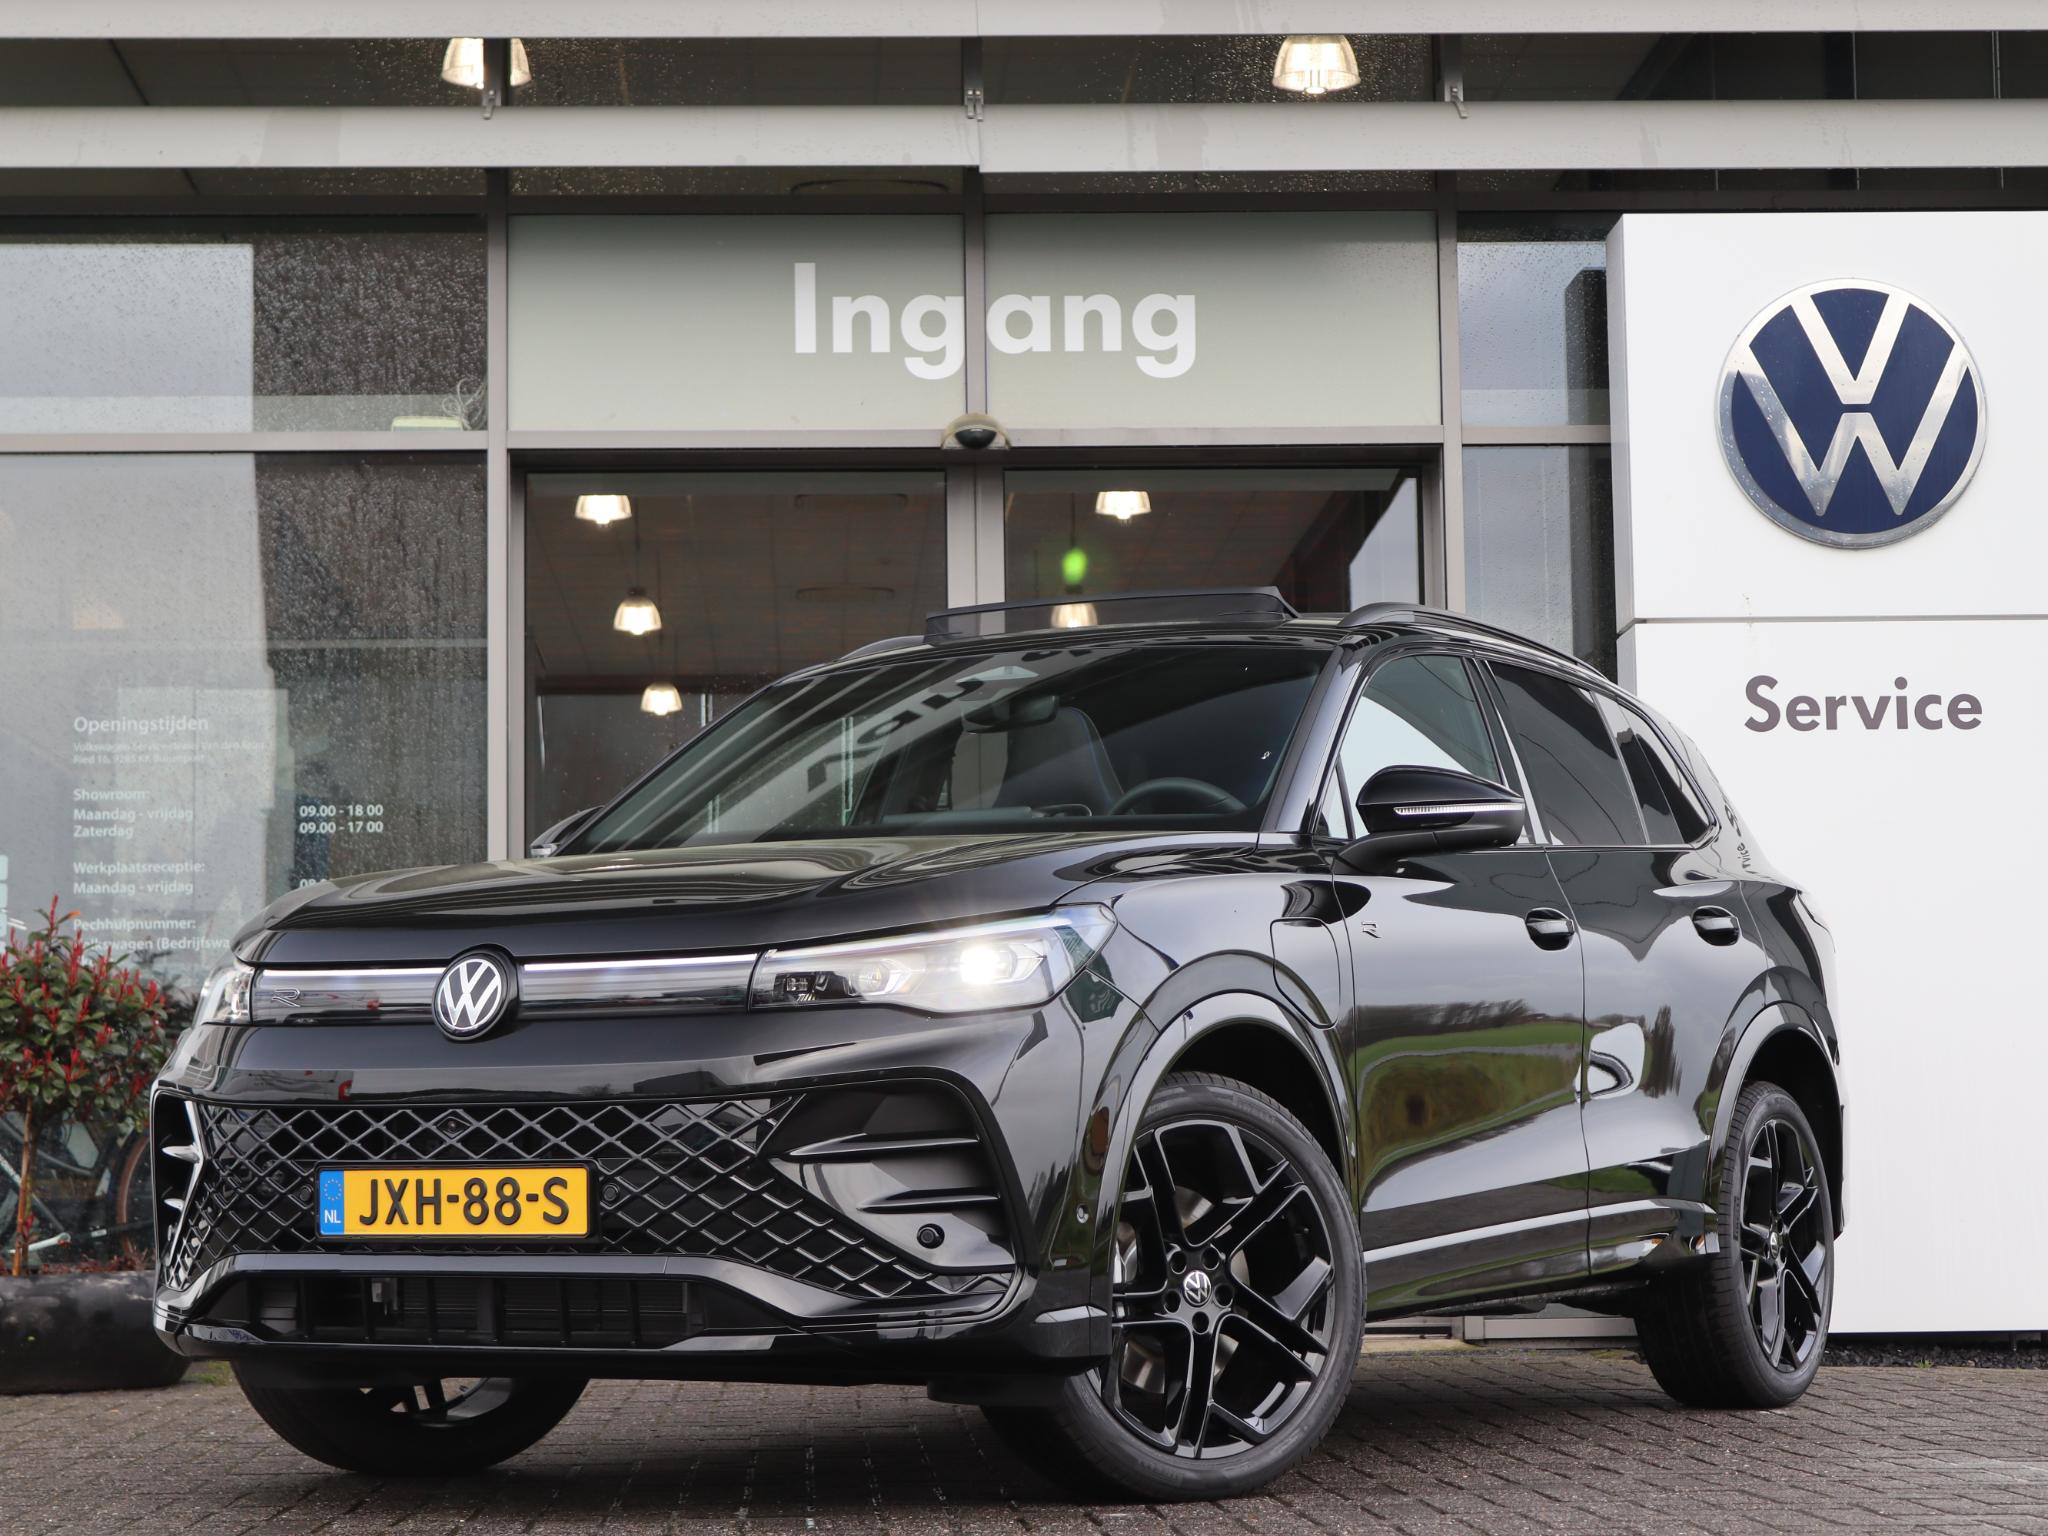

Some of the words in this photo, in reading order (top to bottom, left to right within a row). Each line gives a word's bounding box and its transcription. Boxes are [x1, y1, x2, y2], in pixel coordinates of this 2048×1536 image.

[793, 262, 1196, 380] Ingang
[1744, 675, 1983, 733] Service
[73, 715, 208, 735] Openingstijden
[73, 808, 136, 822] Maandag
[147, 806, 193, 821] vrijdag
[300, 805, 336, 817] 09.00
[73, 824, 133, 839] Zaterdag
[300, 822, 336, 833] 09.00
[73, 861, 205, 876] Werkplaatsreceptie:
[73, 881, 136, 895] Maandag
[147, 880, 193, 895] vrijdag
[73, 918, 196, 932] Pechhulpnummer:
[74, 937, 153, 952] olkswagen
[324, 1210, 341, 1224] NL
[359, 1176, 570, 1226] JXH-88-S
